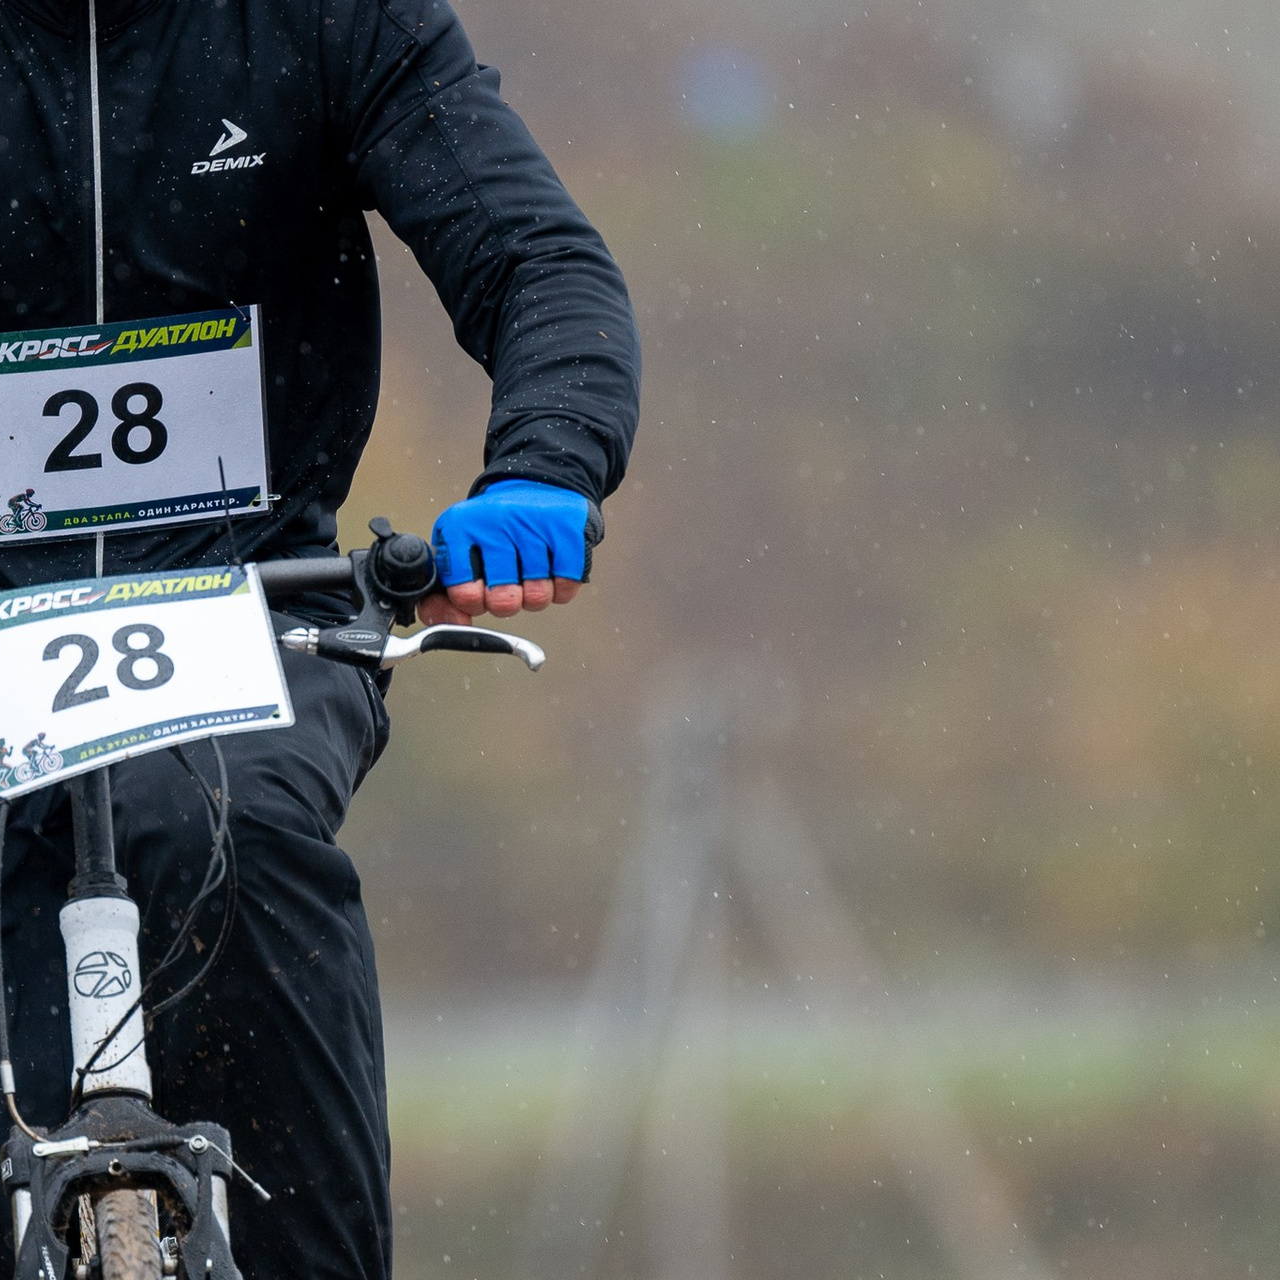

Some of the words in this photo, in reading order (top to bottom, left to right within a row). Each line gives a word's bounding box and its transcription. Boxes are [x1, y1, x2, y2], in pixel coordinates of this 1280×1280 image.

[190, 152, 267, 175] DEMIX
[109, 317, 237, 356] ДУАТЛОН
[41, 381, 169, 474] 28
[63, 516, 89, 527] ДВА
[137, 506, 172, 518] ОДИН
[103, 572, 232, 605] ДУАТЛОН
[41, 622, 175, 714] 28
